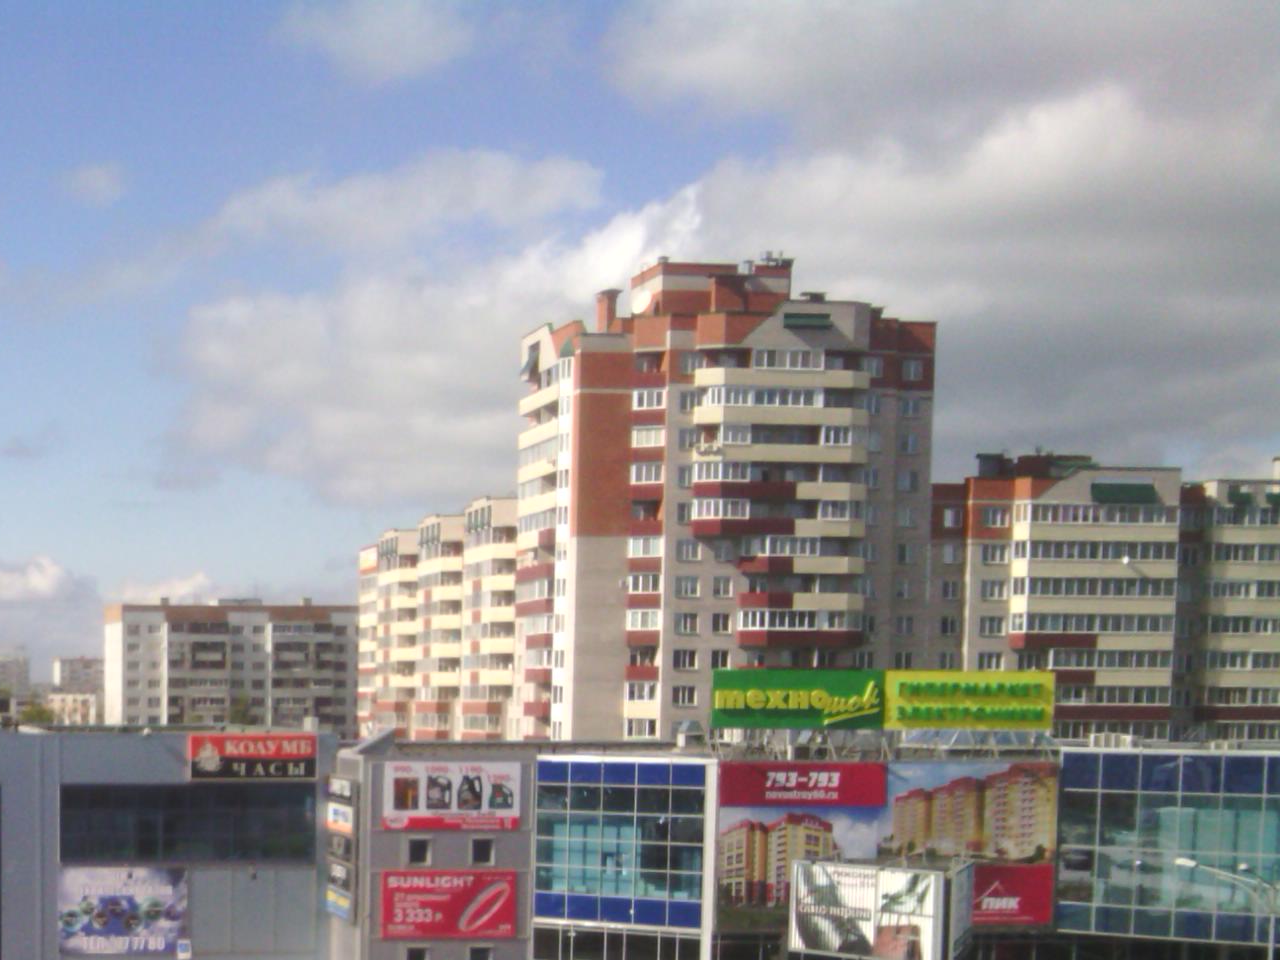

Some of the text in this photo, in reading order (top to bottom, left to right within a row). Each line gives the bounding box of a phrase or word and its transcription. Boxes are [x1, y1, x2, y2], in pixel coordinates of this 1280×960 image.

[224, 739, 313, 755] КОЛУМБ
[231, 762, 306, 777] ЧАСЫ
[765, 771, 841, 788] 793-793
[387, 875, 475, 888] SUNLIGHT
[980, 896, 1022, 911] ПИК
